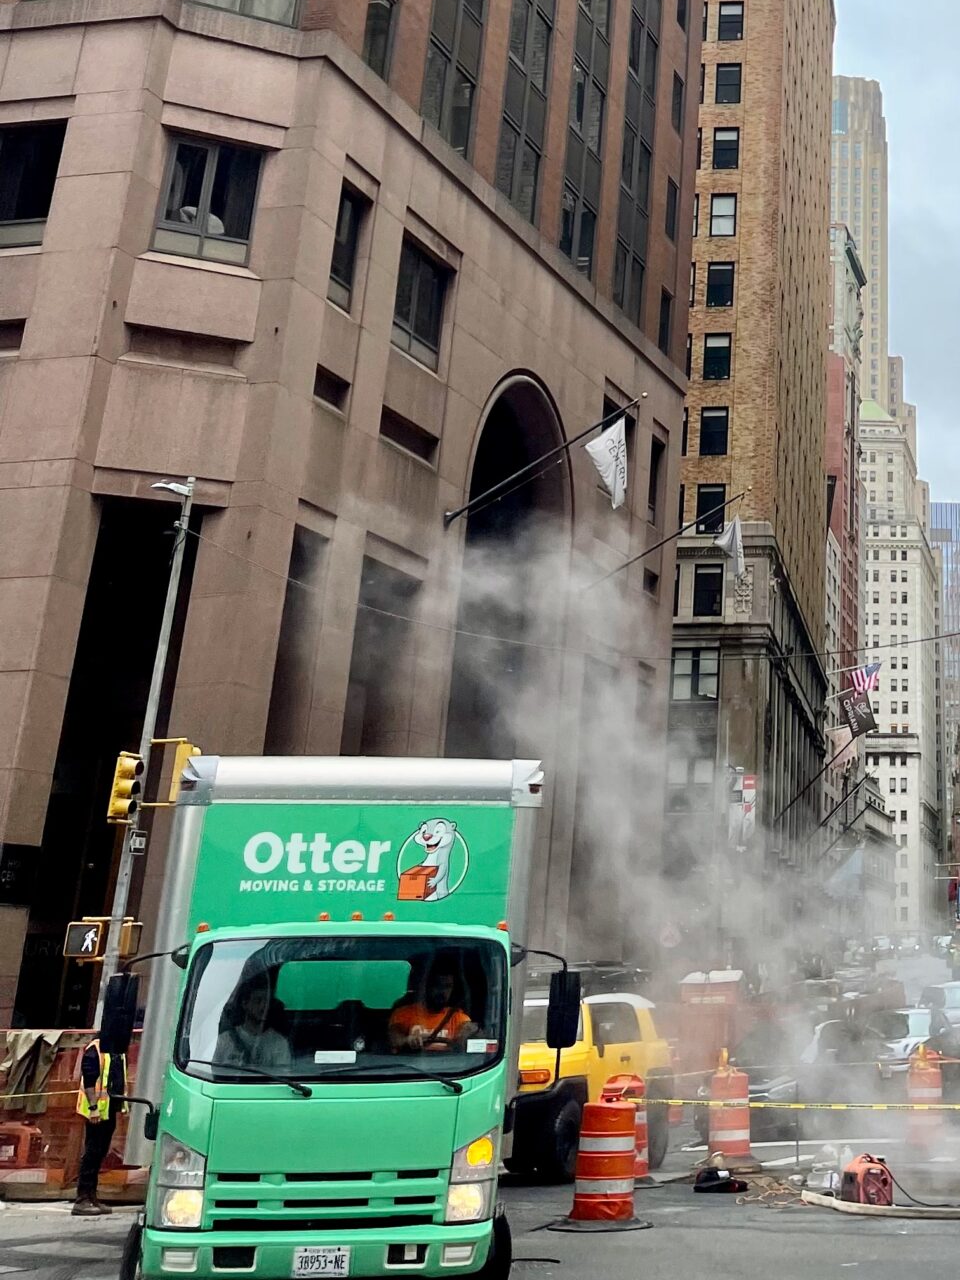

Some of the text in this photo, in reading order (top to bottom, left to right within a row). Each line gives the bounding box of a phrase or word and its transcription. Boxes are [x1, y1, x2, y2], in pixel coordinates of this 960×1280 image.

[843, 699, 859, 732] CIPRIANI
[243, 831, 392, 874] Otter
[239, 879, 386, 892] MOVING & STORAGE
